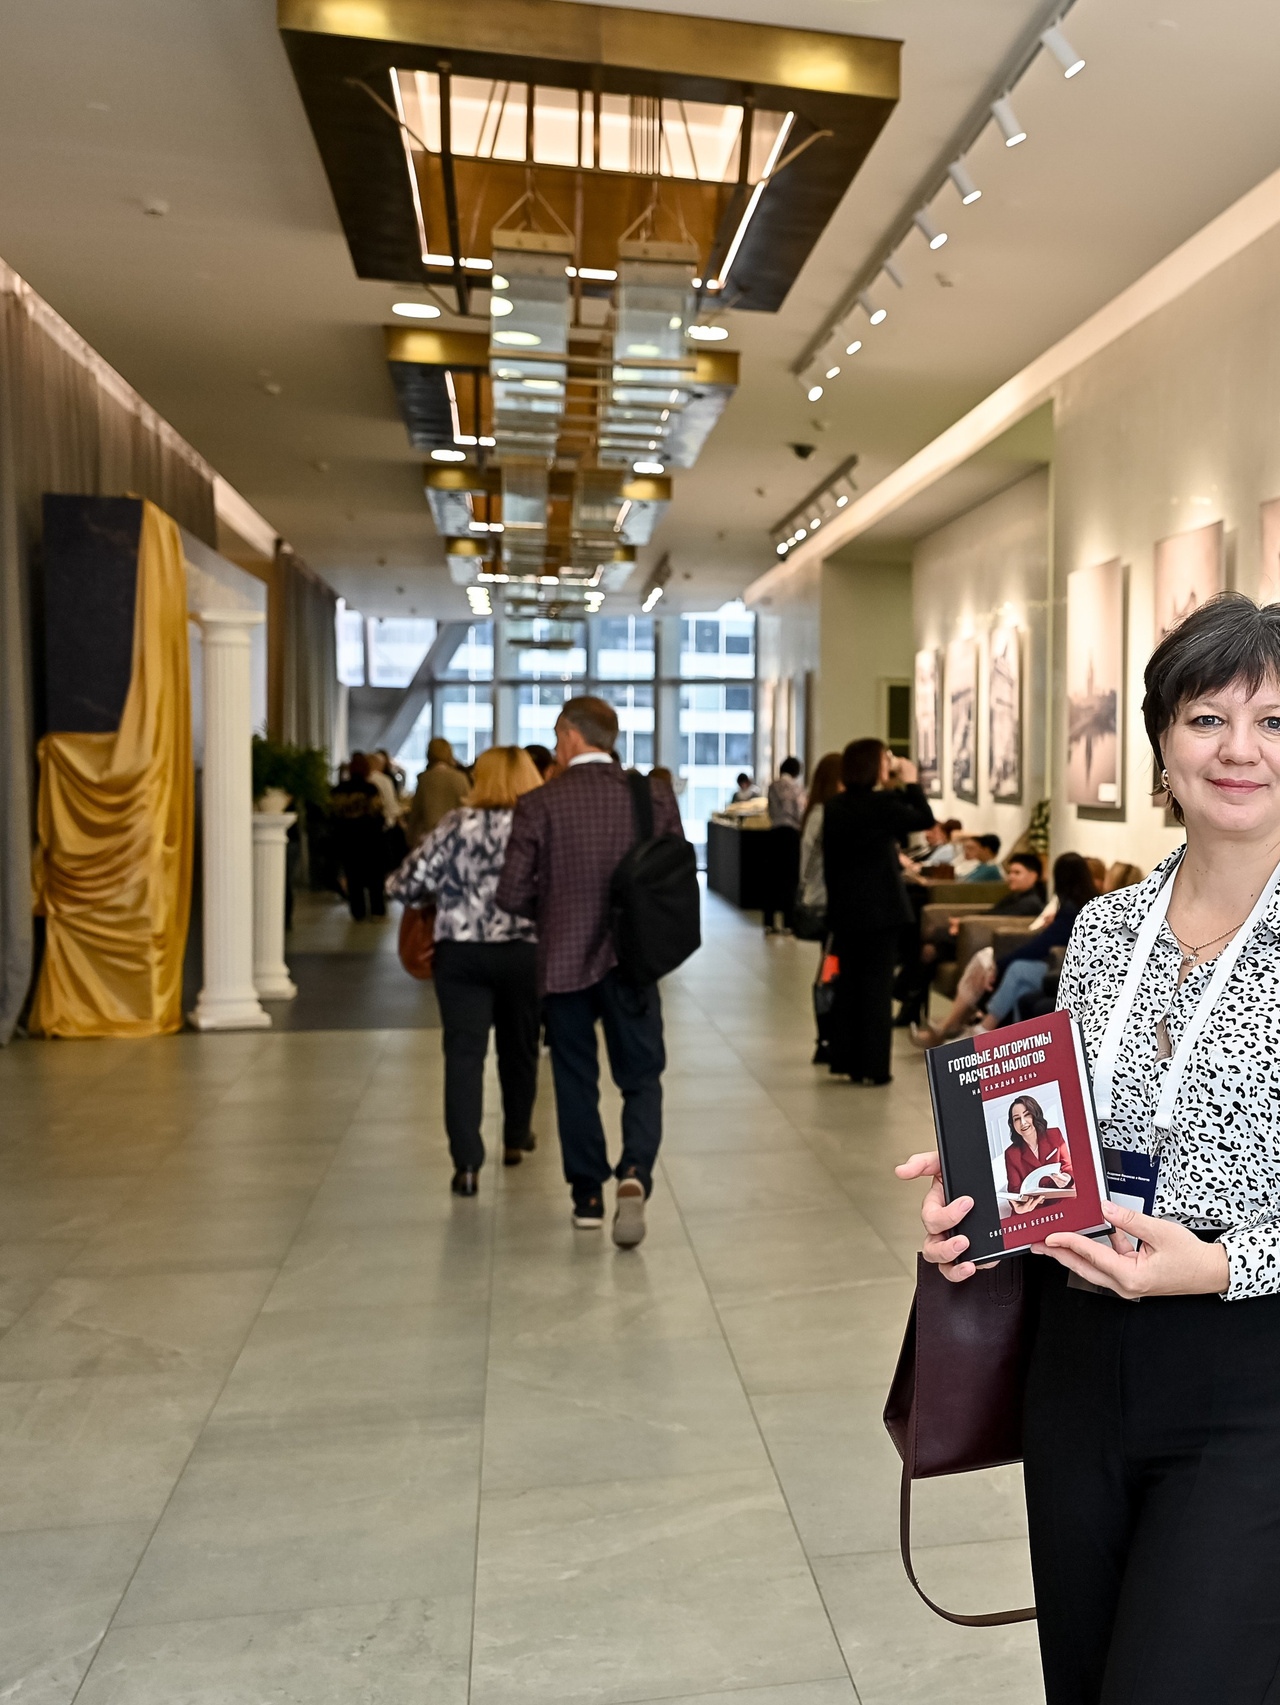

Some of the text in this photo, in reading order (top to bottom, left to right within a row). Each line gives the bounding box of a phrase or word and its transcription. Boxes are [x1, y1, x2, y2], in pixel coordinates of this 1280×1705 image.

[947, 1031, 1053, 1073] ГОТОВЫЕ АЛГОРИТМЫ
[959, 1049, 1046, 1086] РАСЧЕТА НАЛОГОВ
[971, 1071, 1038, 1096] НА КАЖДЫЙ ДЕНЬ
[989, 1212, 1065, 1238] СВЕТЛАНА БЕЛЯЕВА
